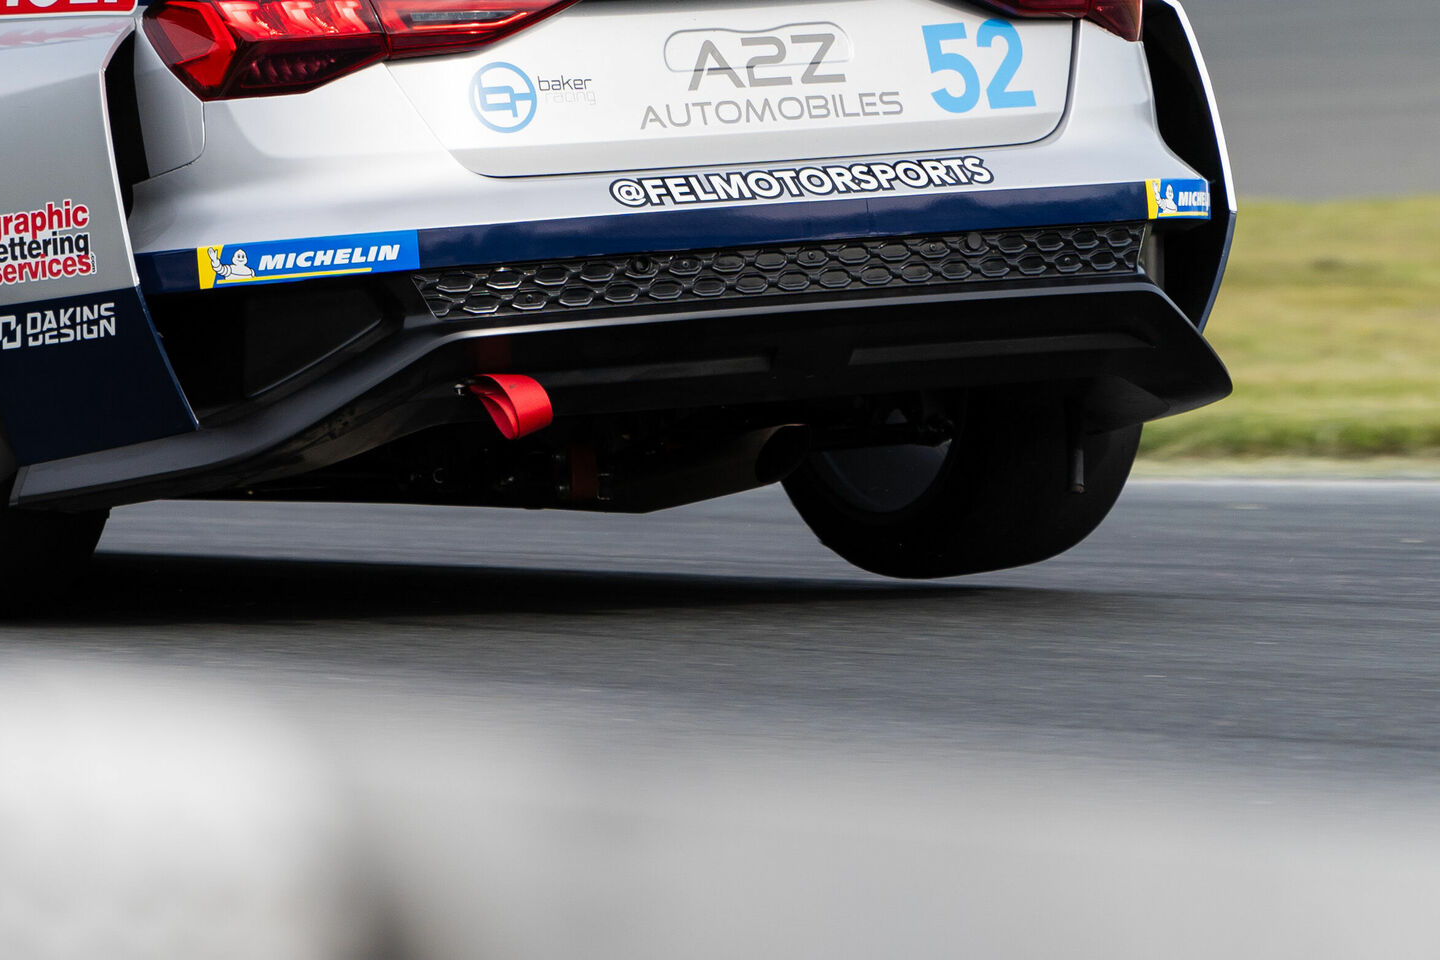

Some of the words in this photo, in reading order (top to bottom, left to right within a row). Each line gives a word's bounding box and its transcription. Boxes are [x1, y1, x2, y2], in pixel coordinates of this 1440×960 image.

[687, 32, 847, 91] A2Z
[920, 18, 1037, 114] 52
[537, 75, 592, 91] baker
[640, 91, 904, 130] AUTOMOBILES
[610, 155, 994, 207] @FELMOTORSPORTS
[257, 244, 401, 271] MICHELIN
[28, 317, 117, 347] DESIGN
